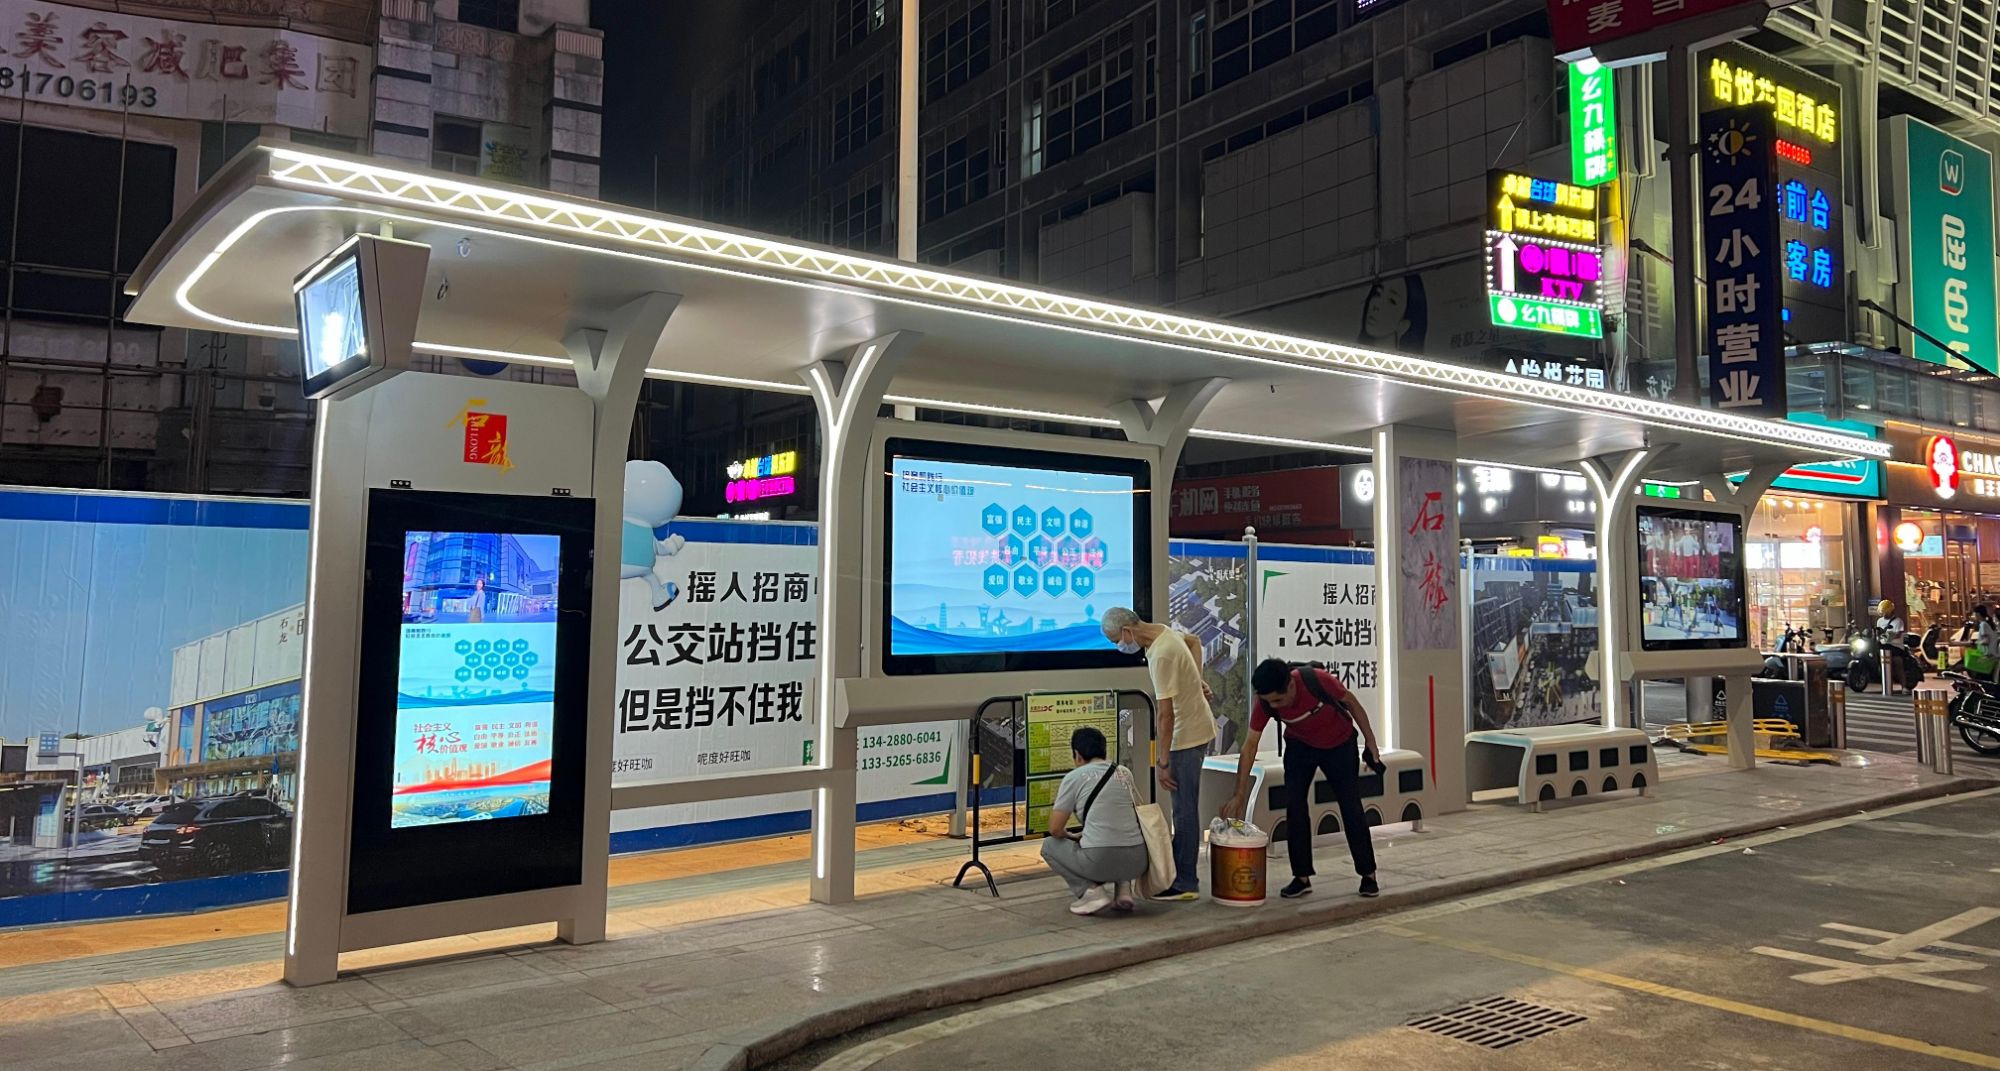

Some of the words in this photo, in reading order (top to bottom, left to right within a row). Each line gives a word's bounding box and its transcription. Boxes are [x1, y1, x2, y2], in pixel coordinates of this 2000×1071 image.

[13, 11, 358, 99] 美容减肥集团
[1786, 240, 1832, 288] 客房
[1541, 276, 1583, 301] KTV
[1709, 177, 1763, 408] 24小时营业
[1521, 358, 1605, 389] 怡悦花园
[687, 571, 818, 603] 摇人招商
[624, 621, 817, 666] 公交站挡住
[1294, 618, 1377, 648] 公交站挡
[619, 680, 803, 734] 但是挡不住我
[861, 731, 942, 749] 134-2880-6041
[861, 751, 942, 770] 133-5265-6836
